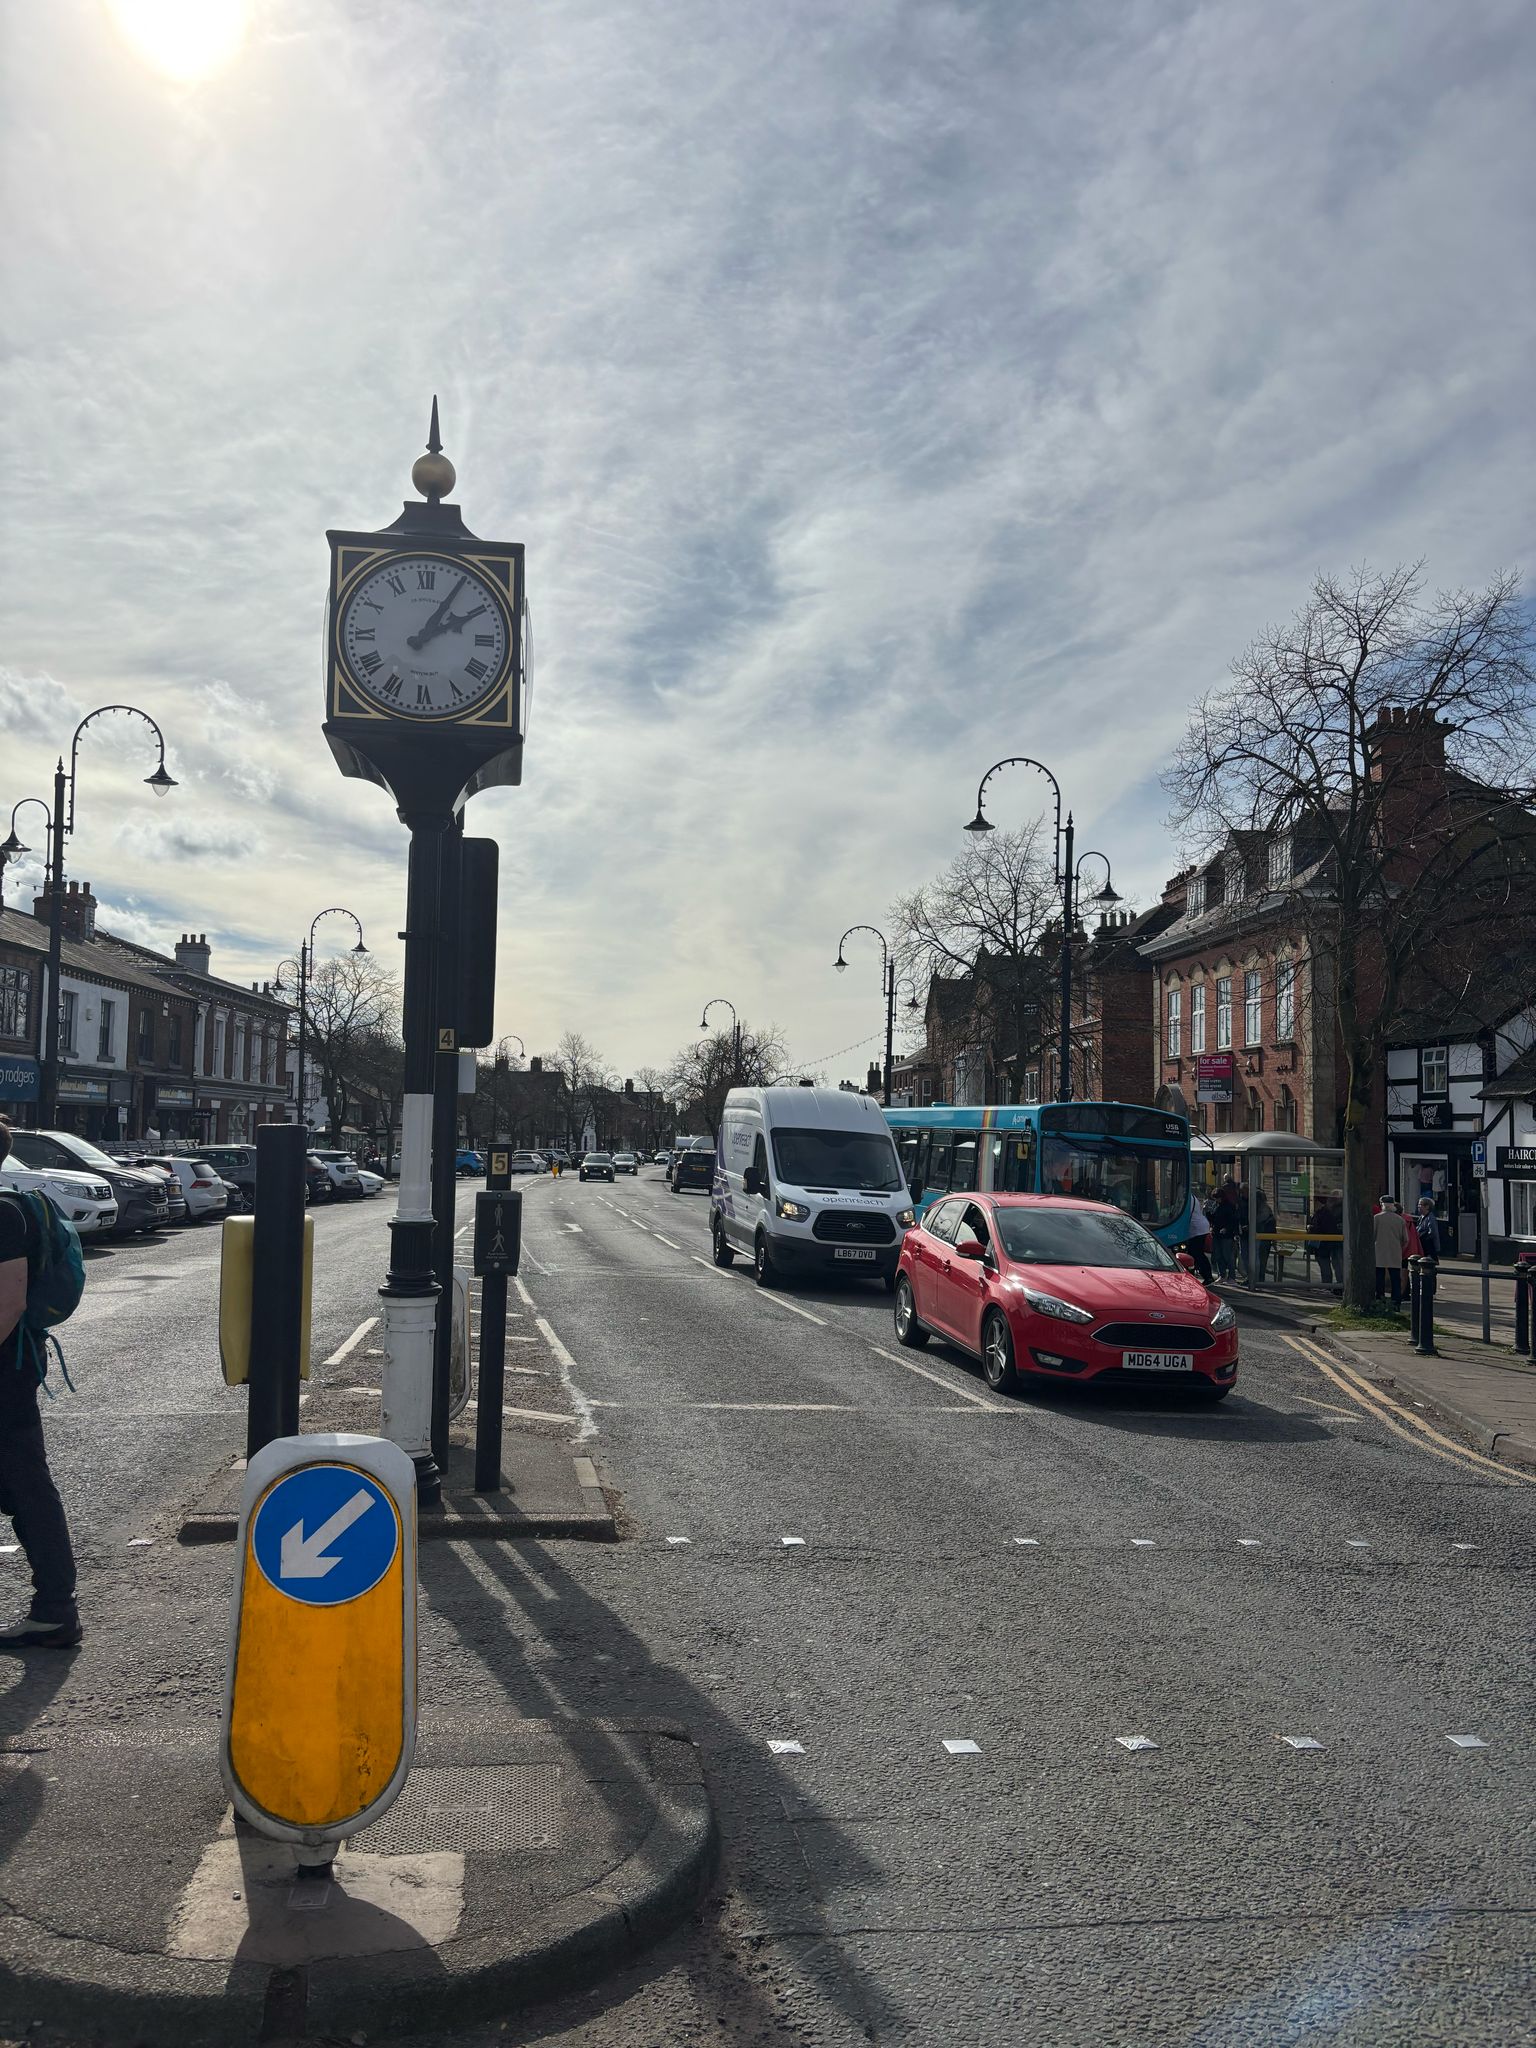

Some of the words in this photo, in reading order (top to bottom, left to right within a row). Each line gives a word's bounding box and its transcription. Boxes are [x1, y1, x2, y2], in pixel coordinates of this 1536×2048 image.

[385, 575, 407, 598] XI
[417, 570, 436, 590] XII
[363, 597, 384, 615] X
[355, 627, 375, 641] IX
[474, 634, 495, 648] III
[359, 650, 385, 677] VIII
[464, 657, 489, 681] IIII
[382, 673, 404, 698] VII
[448, 679, 463, 699] V
[416, 684, 432, 705] VI
[441, 1030, 452, 1046] 4
[1200, 1057, 1211, 1065] for
[1212, 1057, 1227, 1065] sale
[5, 1065, 35, 1088] rodgers
[1165, 1123, 1179, 1131] USB
[1475, 1143, 1483, 1160] P
[495, 1155, 506, 1172] 5
[822, 1196, 885, 1207] openreach
[837, 1249, 857, 1258] LB67
[1128, 1353, 1160, 1367] MD64
[1163, 1355, 1187, 1368] UGA
